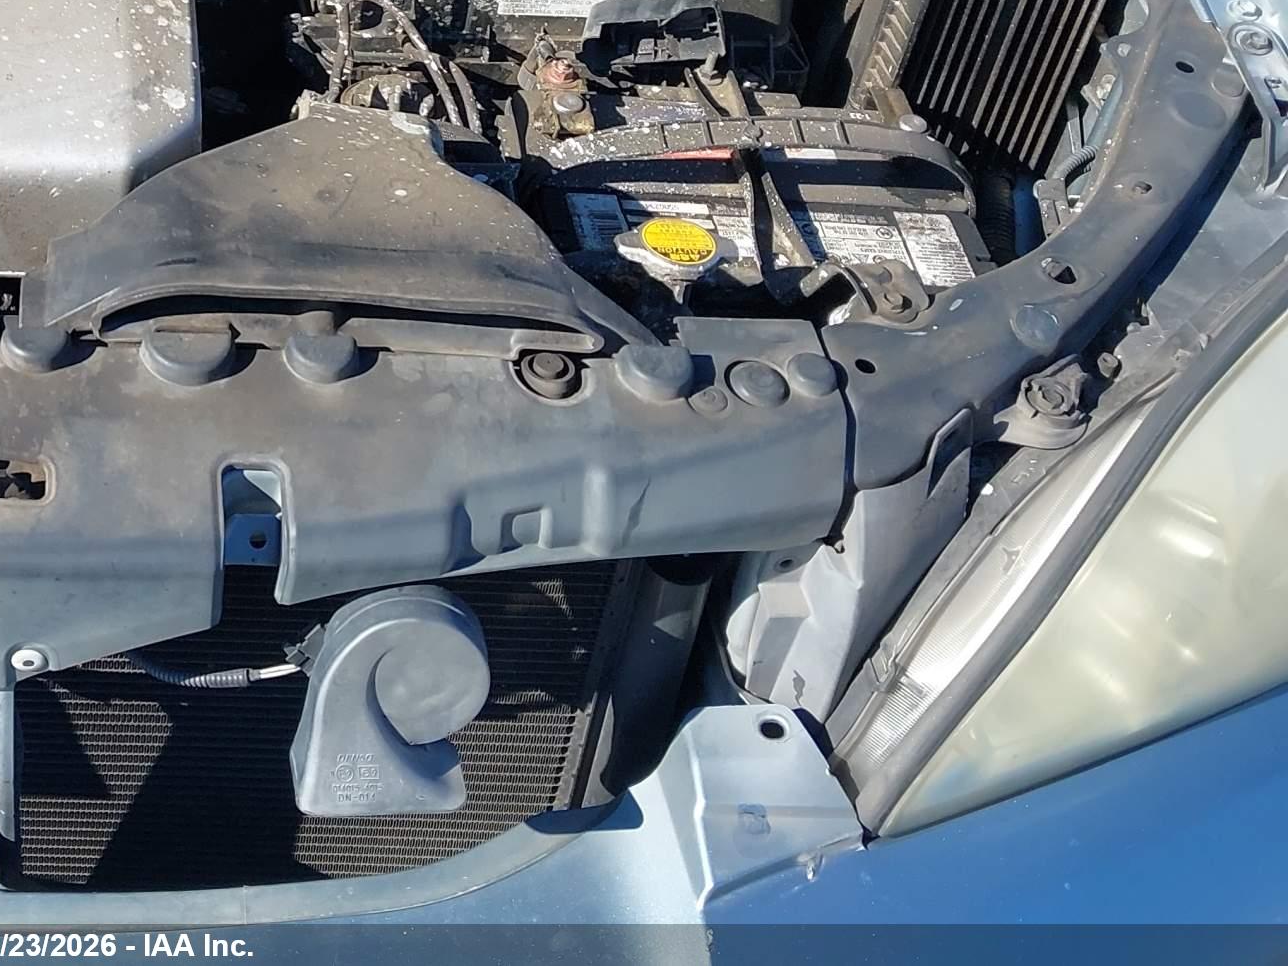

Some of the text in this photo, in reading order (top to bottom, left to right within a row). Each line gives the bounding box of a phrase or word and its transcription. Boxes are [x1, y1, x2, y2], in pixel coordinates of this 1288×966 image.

[657, 246, 709, 255] CAUTION
[337, 753, 374, 762] DENSO
[337, 792, 376, 802] DN-014
